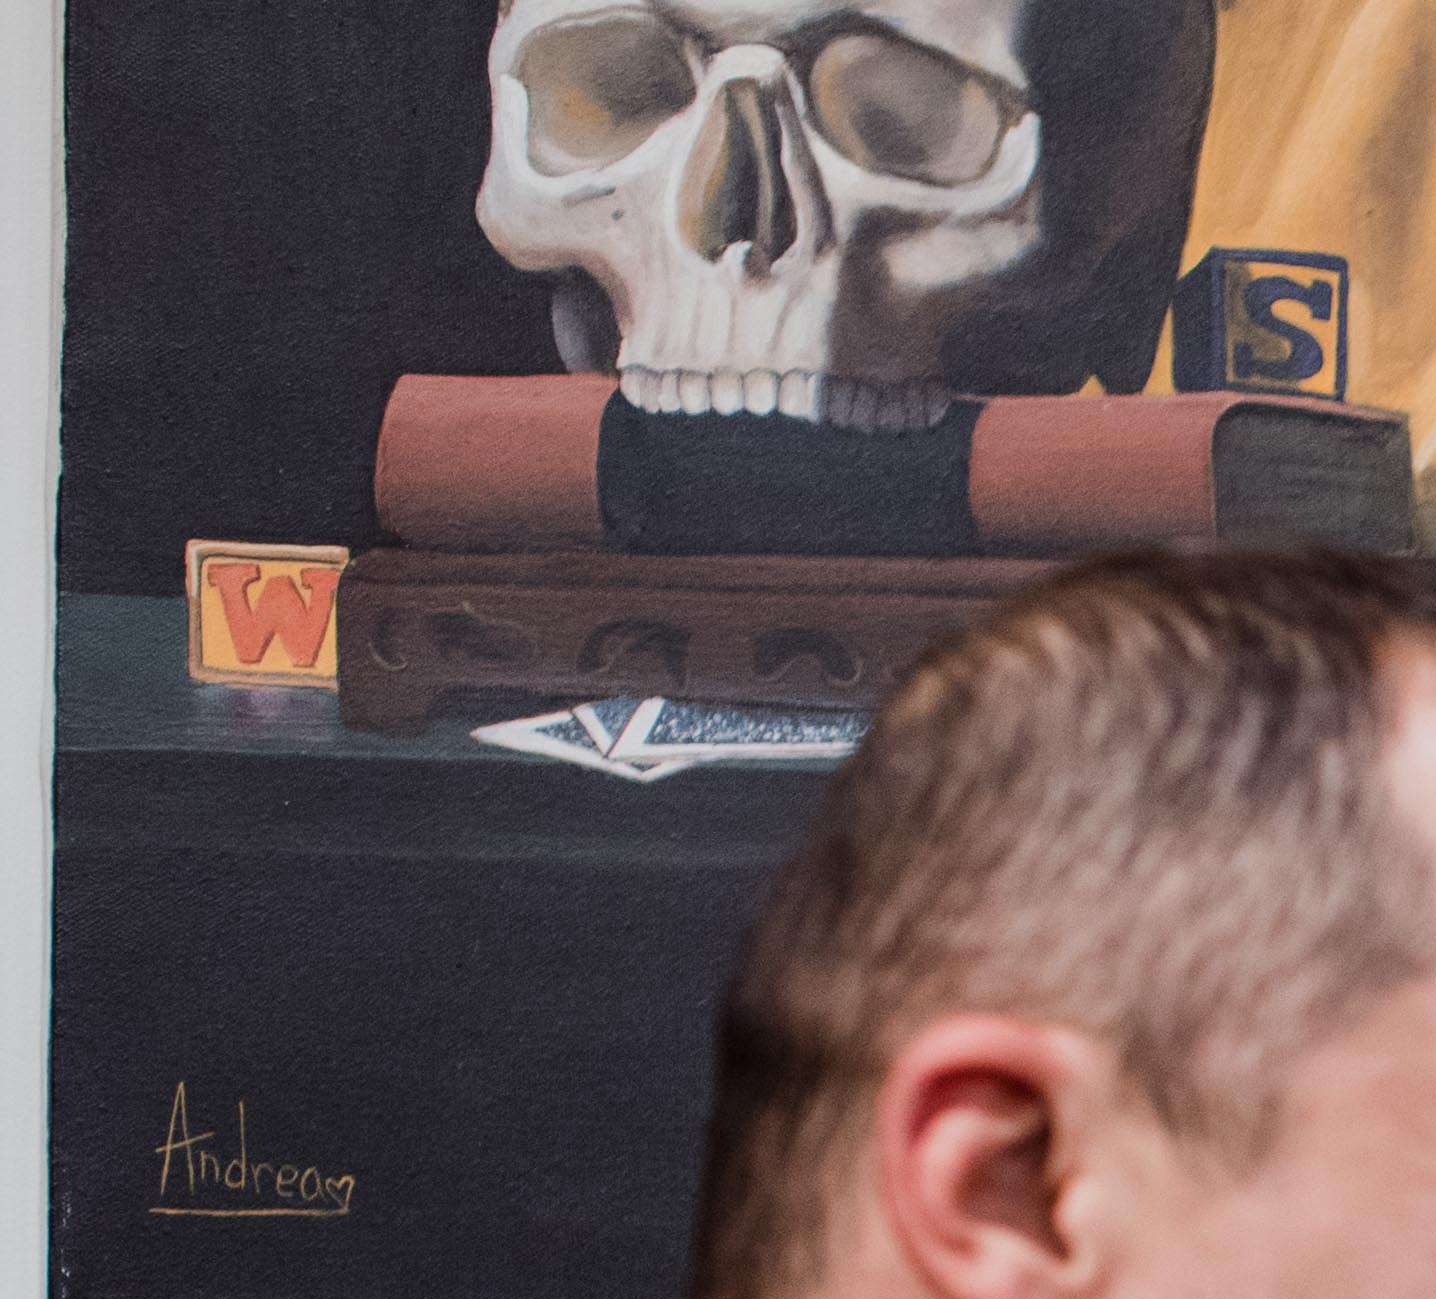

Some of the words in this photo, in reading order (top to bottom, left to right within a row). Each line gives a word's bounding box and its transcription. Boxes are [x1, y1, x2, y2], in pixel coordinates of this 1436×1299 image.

[1233, 276, 1333, 380] S
[207, 562, 341, 668] W
[155, 1080, 325, 1201] Andrea
